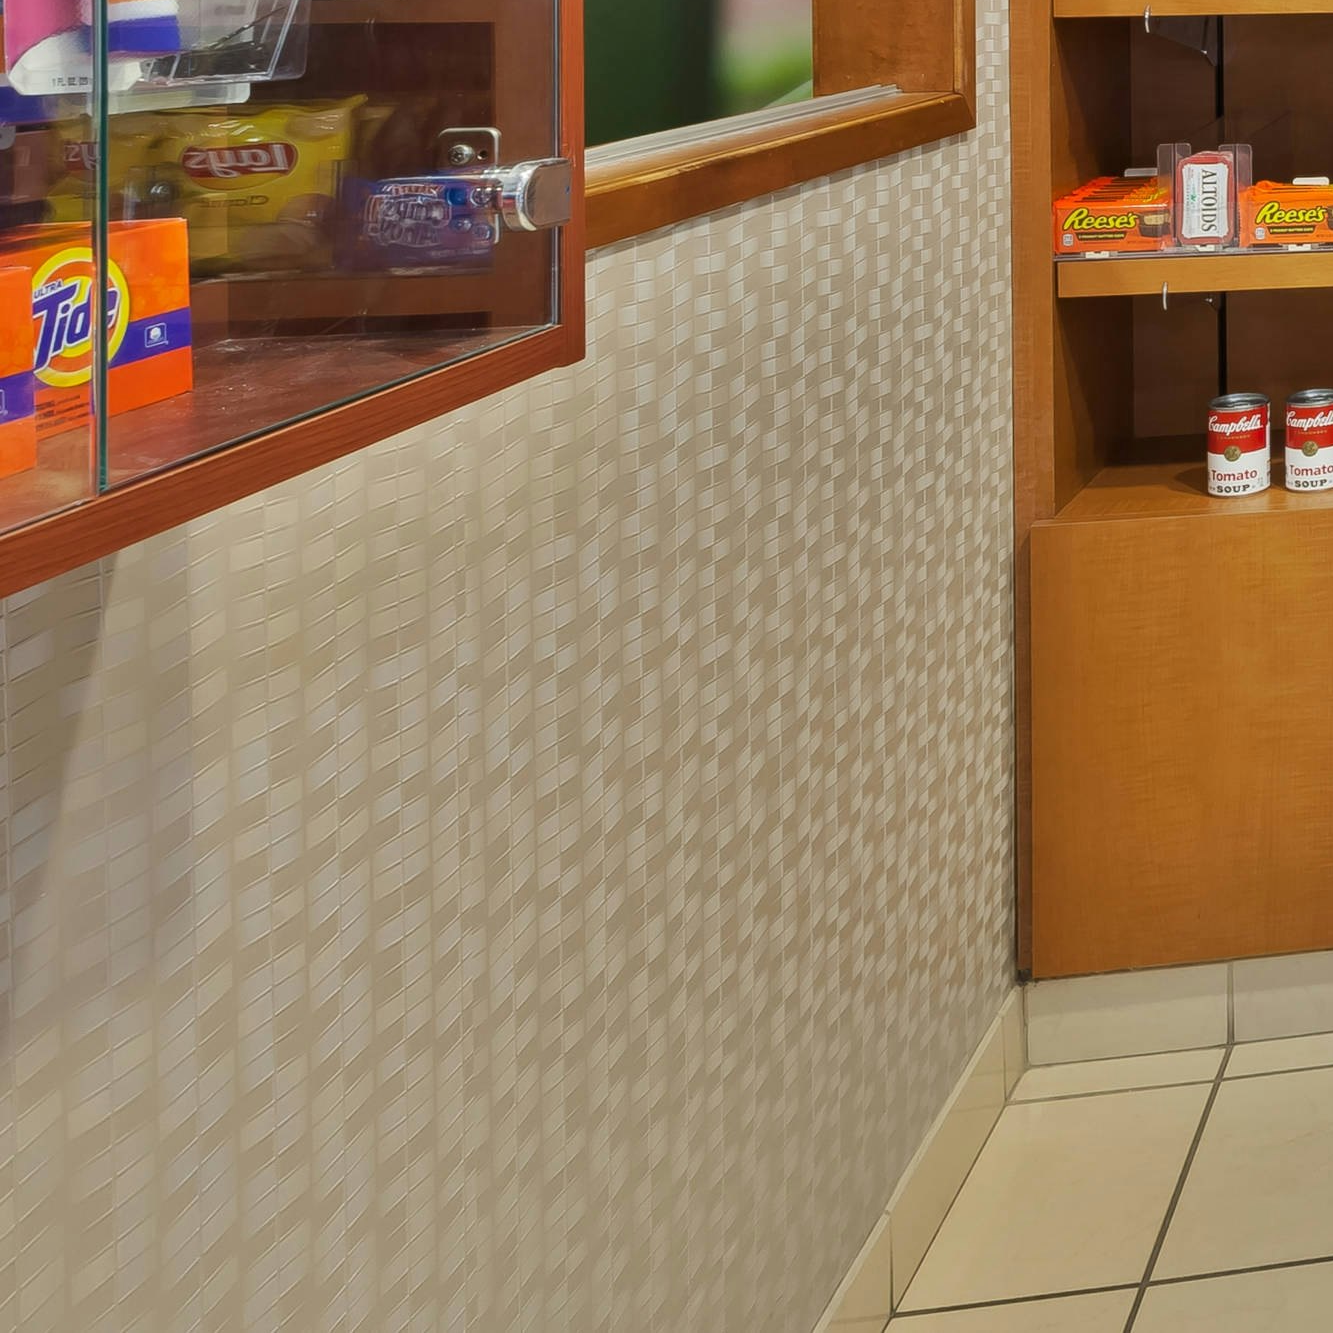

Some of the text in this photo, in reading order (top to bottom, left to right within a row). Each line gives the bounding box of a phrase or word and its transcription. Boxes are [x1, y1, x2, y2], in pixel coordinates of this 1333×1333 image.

[1201, 168, 1218, 233] ALTOIDS
[1063, 207, 1138, 230] Reese's
[1256, 202, 1327, 225] Reese's
[34, 280, 62, 299] ULTRA
[1209, 414, 1263, 436] Campbell's
[1212, 470, 1257, 482] Tomato
[1290, 465, 1333, 476] Tomato
[1217, 484, 1250, 493] SOUP
[1294, 479, 1328, 488] SOUP
